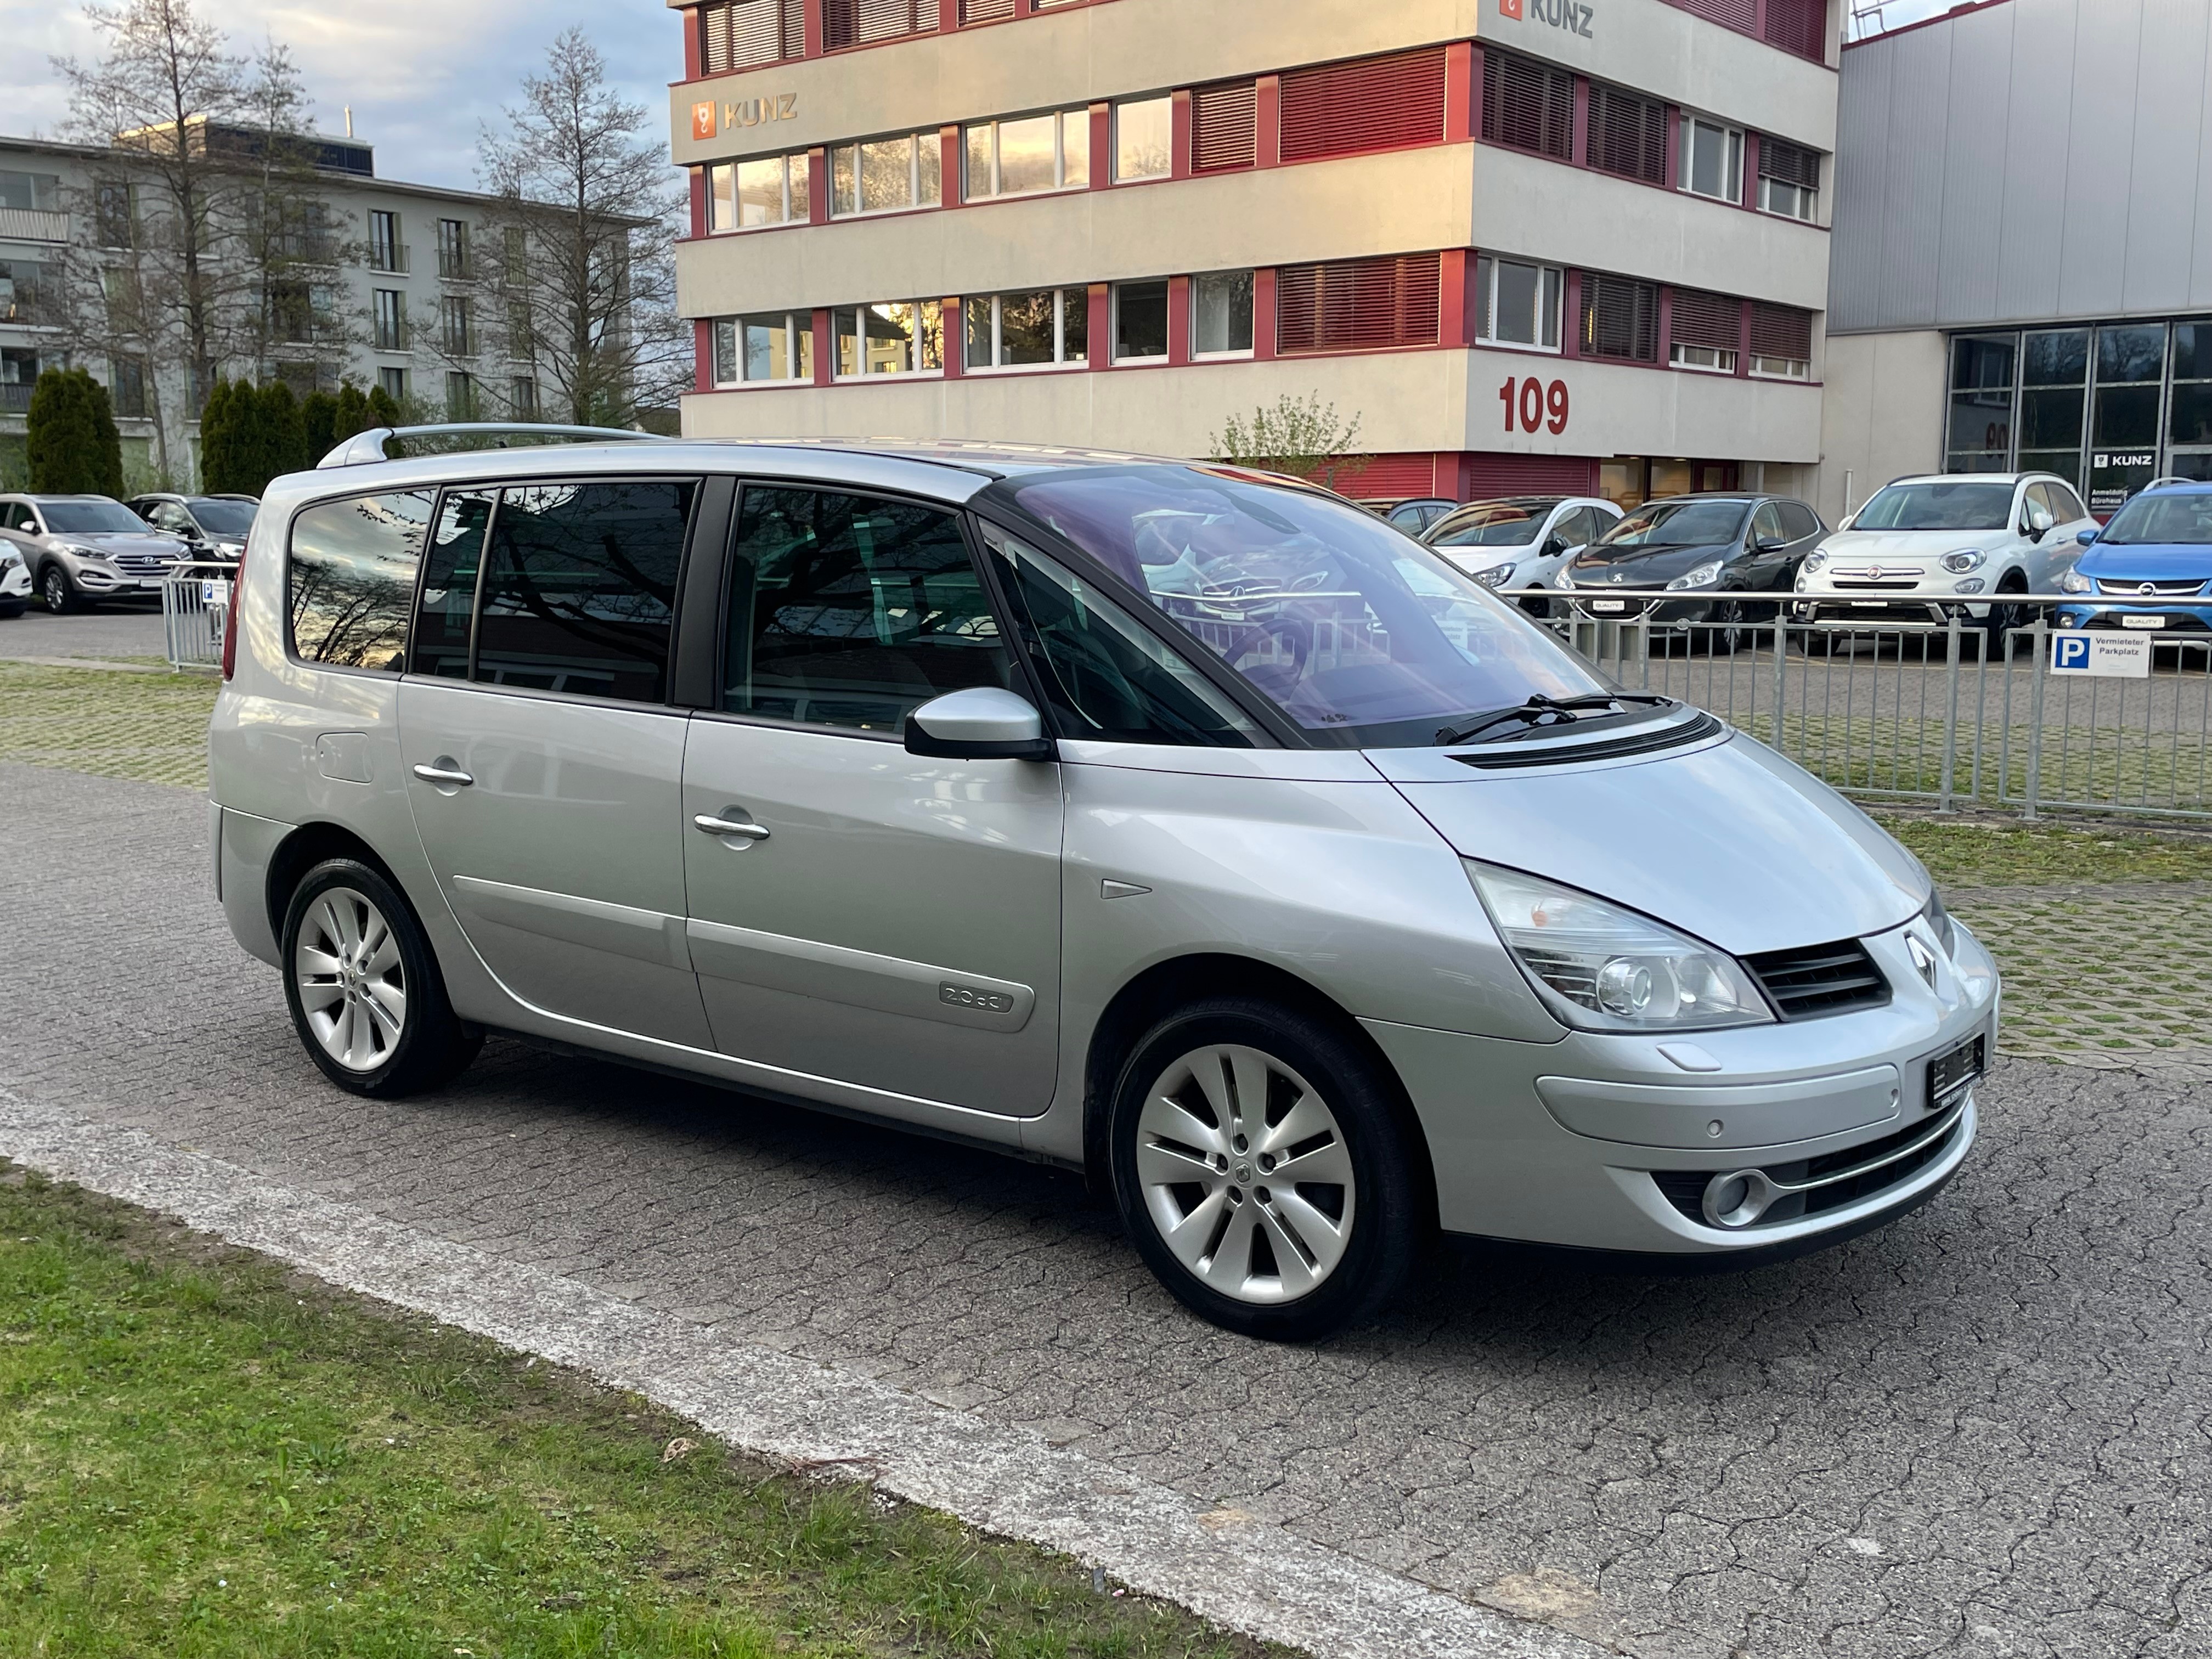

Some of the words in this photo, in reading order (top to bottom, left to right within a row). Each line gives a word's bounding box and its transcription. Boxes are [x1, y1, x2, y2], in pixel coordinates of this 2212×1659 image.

[1531, 0, 1593, 39] KUNZ
[725, 92, 798, 129] KUNZ
[1499, 377, 1568, 435] 109
[2112, 455, 2152, 466] KUNZ
[2061, 638, 2085, 667] P
[2095, 637, 2145, 646] Vermieteter
[2099, 647, 2139, 656] Parkplatz
